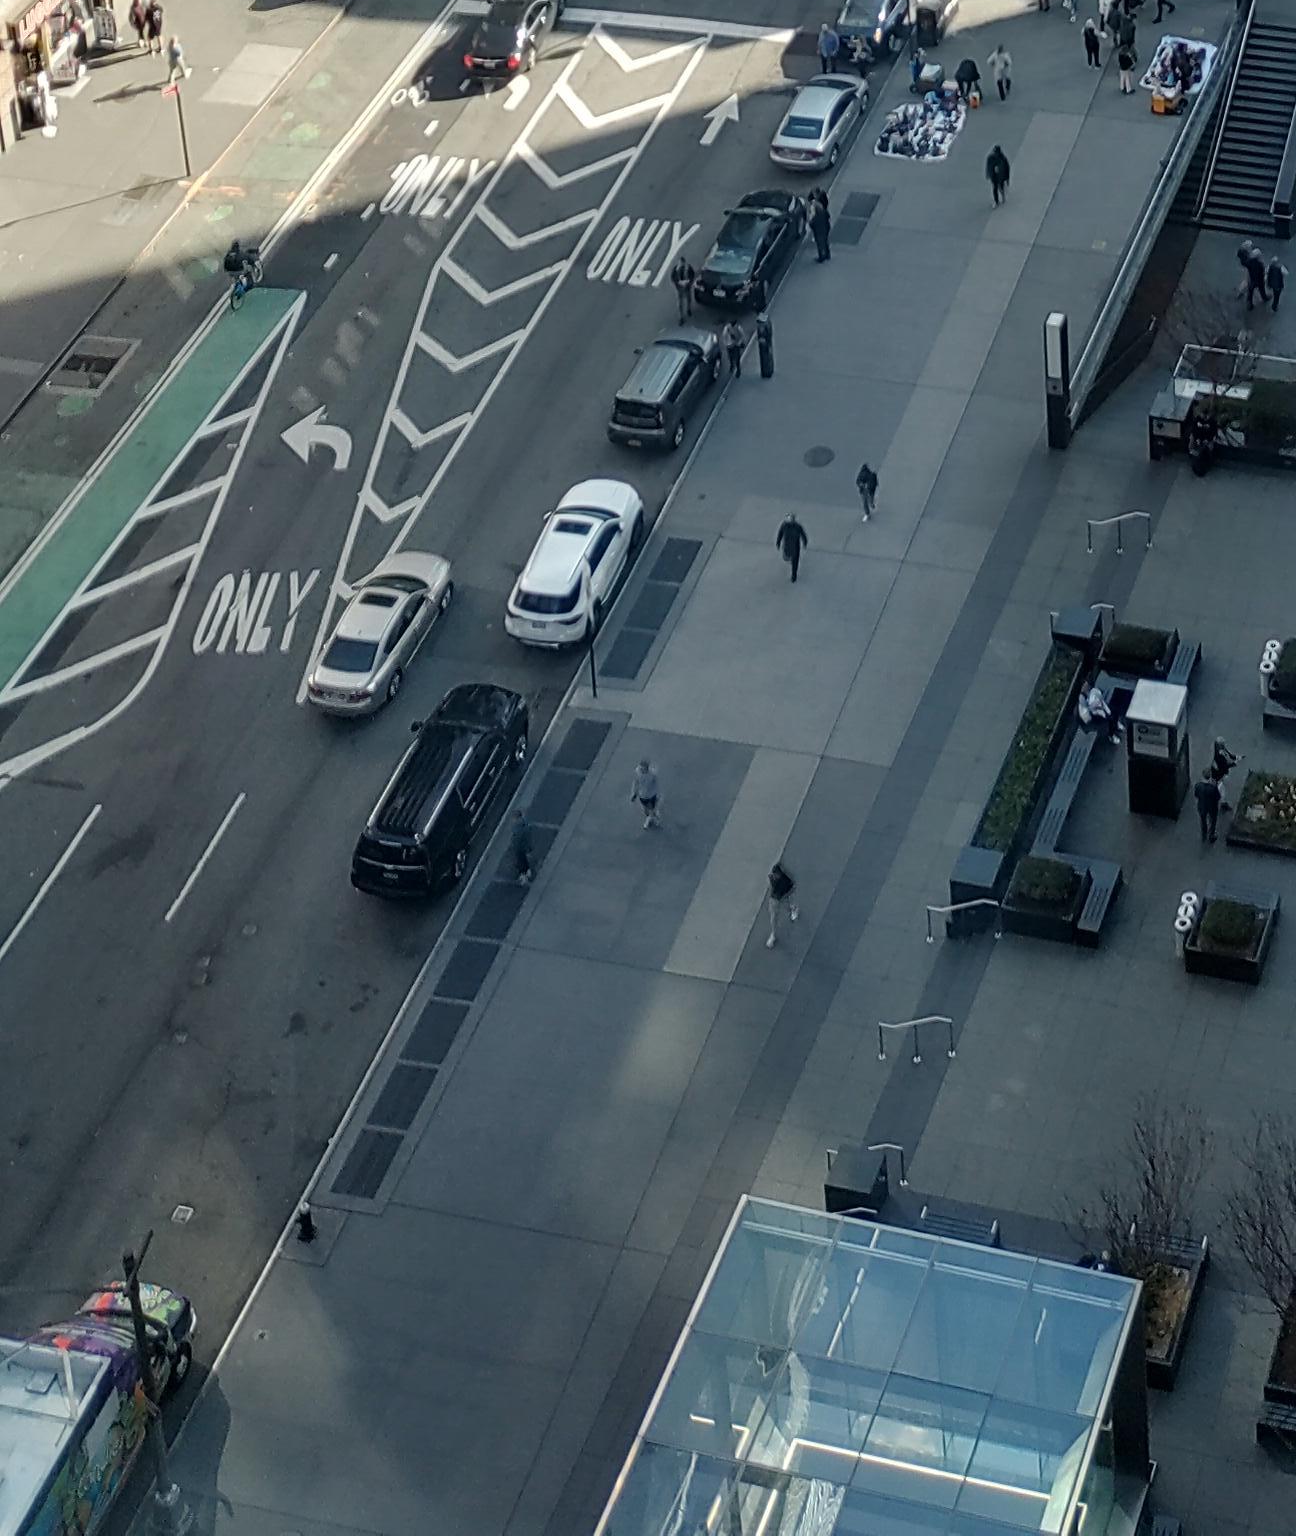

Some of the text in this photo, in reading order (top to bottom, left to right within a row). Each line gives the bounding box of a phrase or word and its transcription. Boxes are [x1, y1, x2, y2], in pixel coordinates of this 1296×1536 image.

[379, 154, 497, 219] ONLY
[587, 216, 700, 286] ONLY
[192, 569, 321, 655] ONLY
